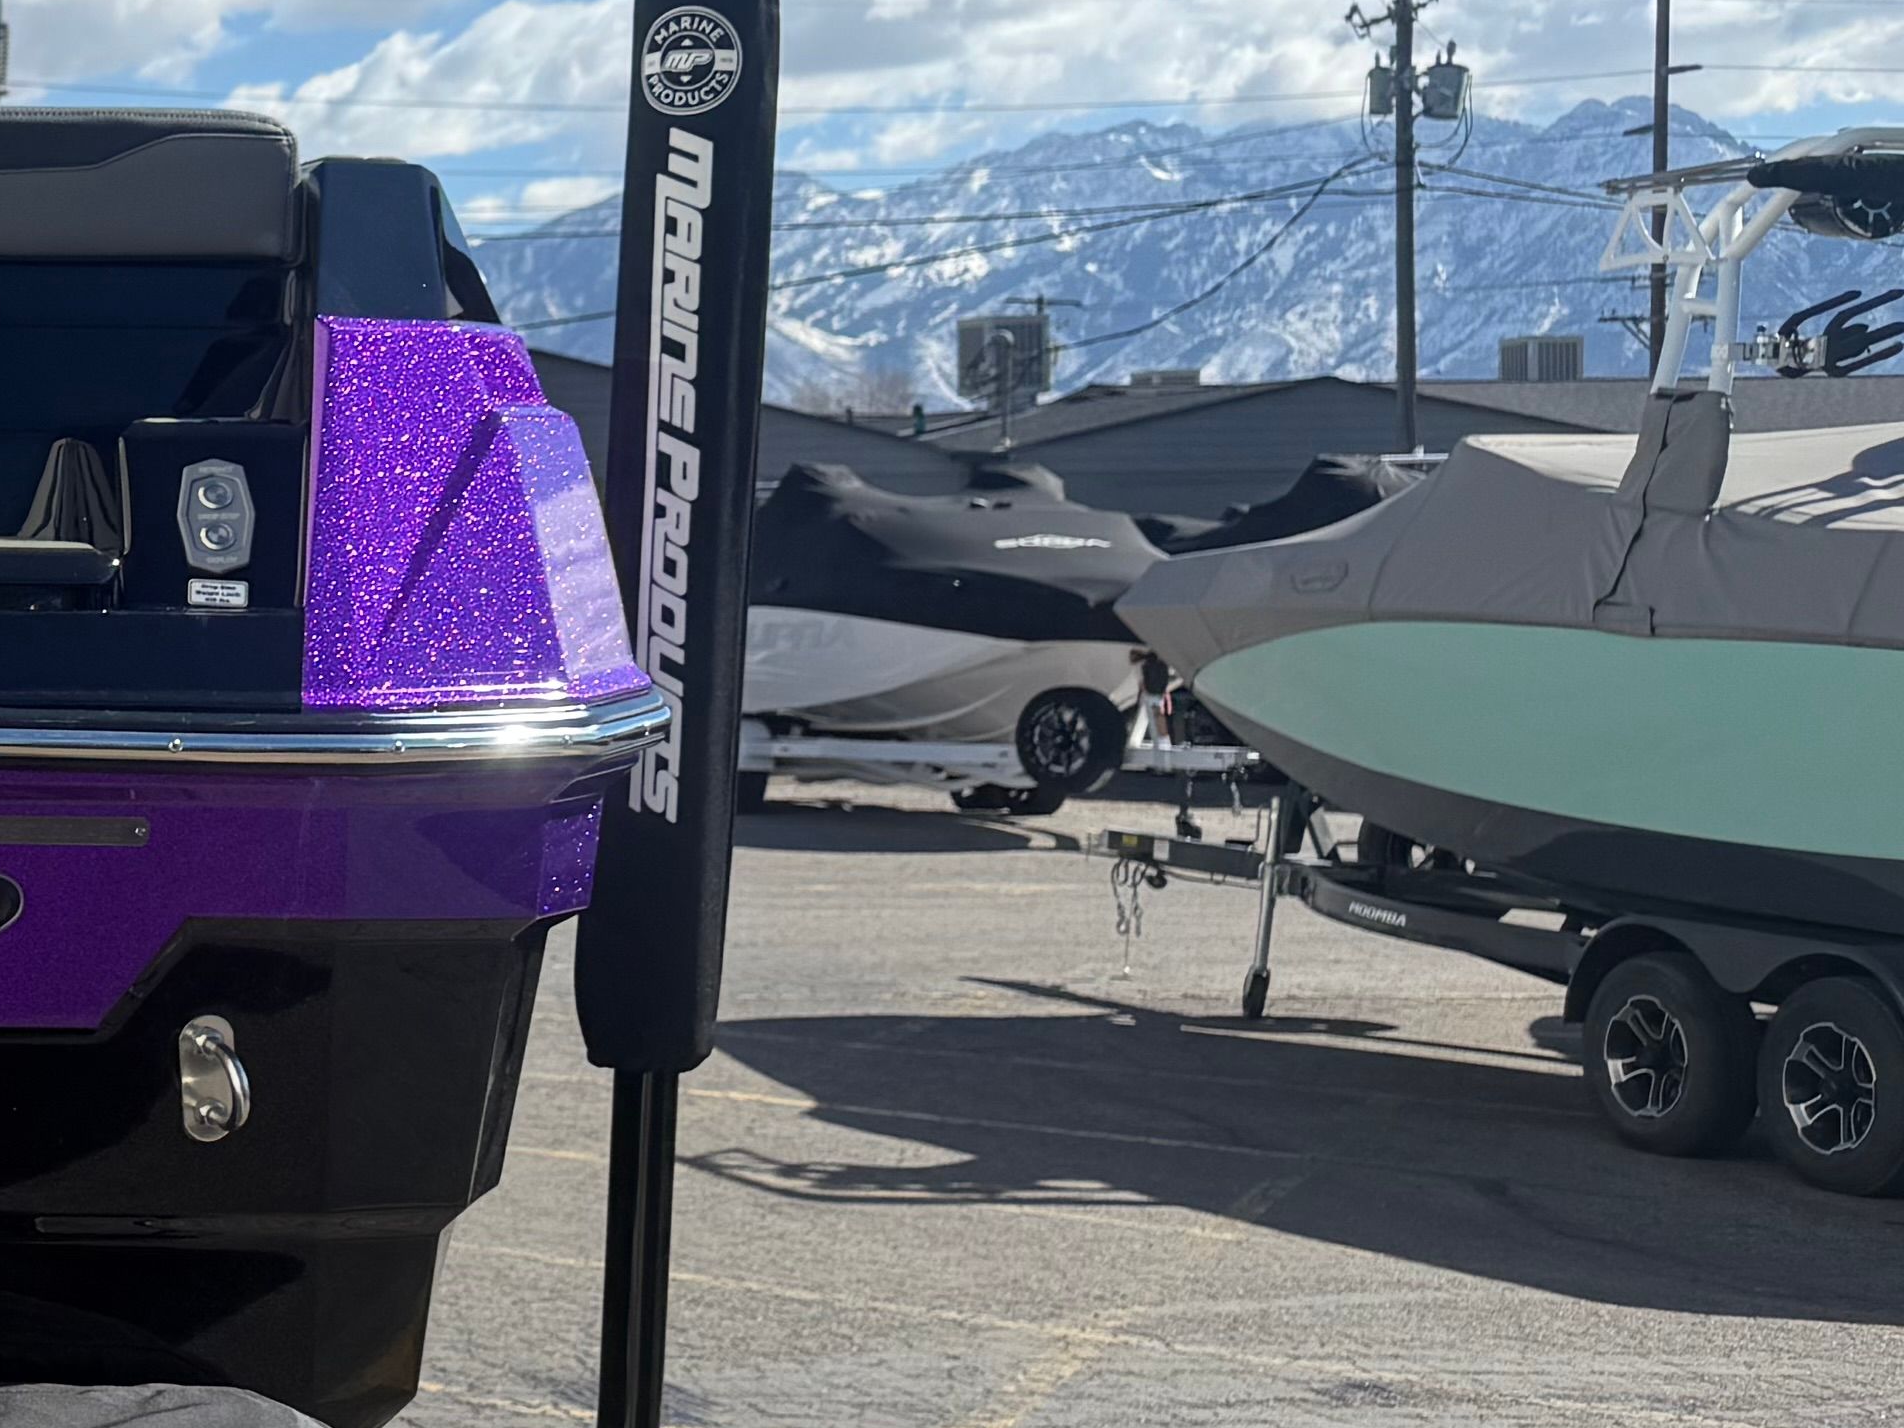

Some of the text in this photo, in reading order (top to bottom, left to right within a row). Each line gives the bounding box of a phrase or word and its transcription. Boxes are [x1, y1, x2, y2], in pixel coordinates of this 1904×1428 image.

[654, 16, 725, 45] MARINE
[648, 72, 730, 107] PRODUCTS
[658, 126, 714, 434] MARINE
